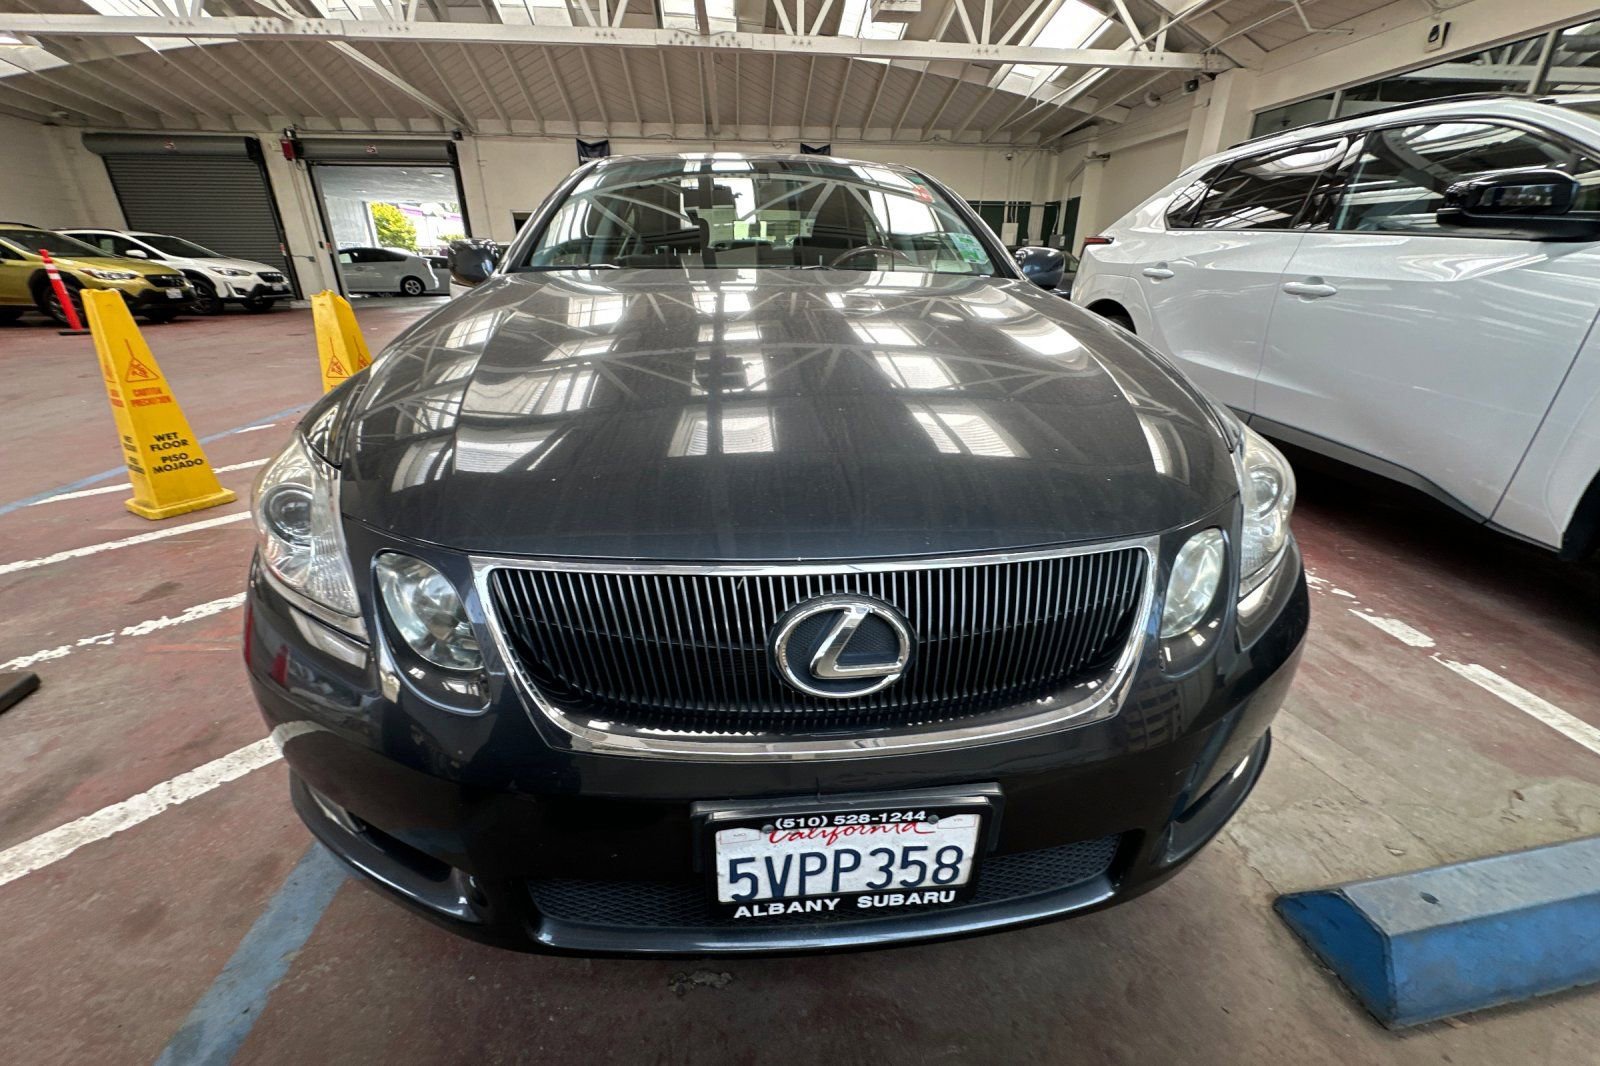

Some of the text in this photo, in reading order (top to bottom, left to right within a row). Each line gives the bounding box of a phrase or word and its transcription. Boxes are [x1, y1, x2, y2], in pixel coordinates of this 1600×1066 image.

[150, 439, 189, 451] FLOOR
[154, 432, 178, 441] WET
[153, 458, 203, 473] MOJADO
[161, 453, 188, 463] PISO
[775, 811, 926, 830] (510) 528-1244
[769, 822, 936, 846] California
[729, 845, 963, 901] 5VPP358
[734, 890, 955, 918] ALBANY SUBARU
